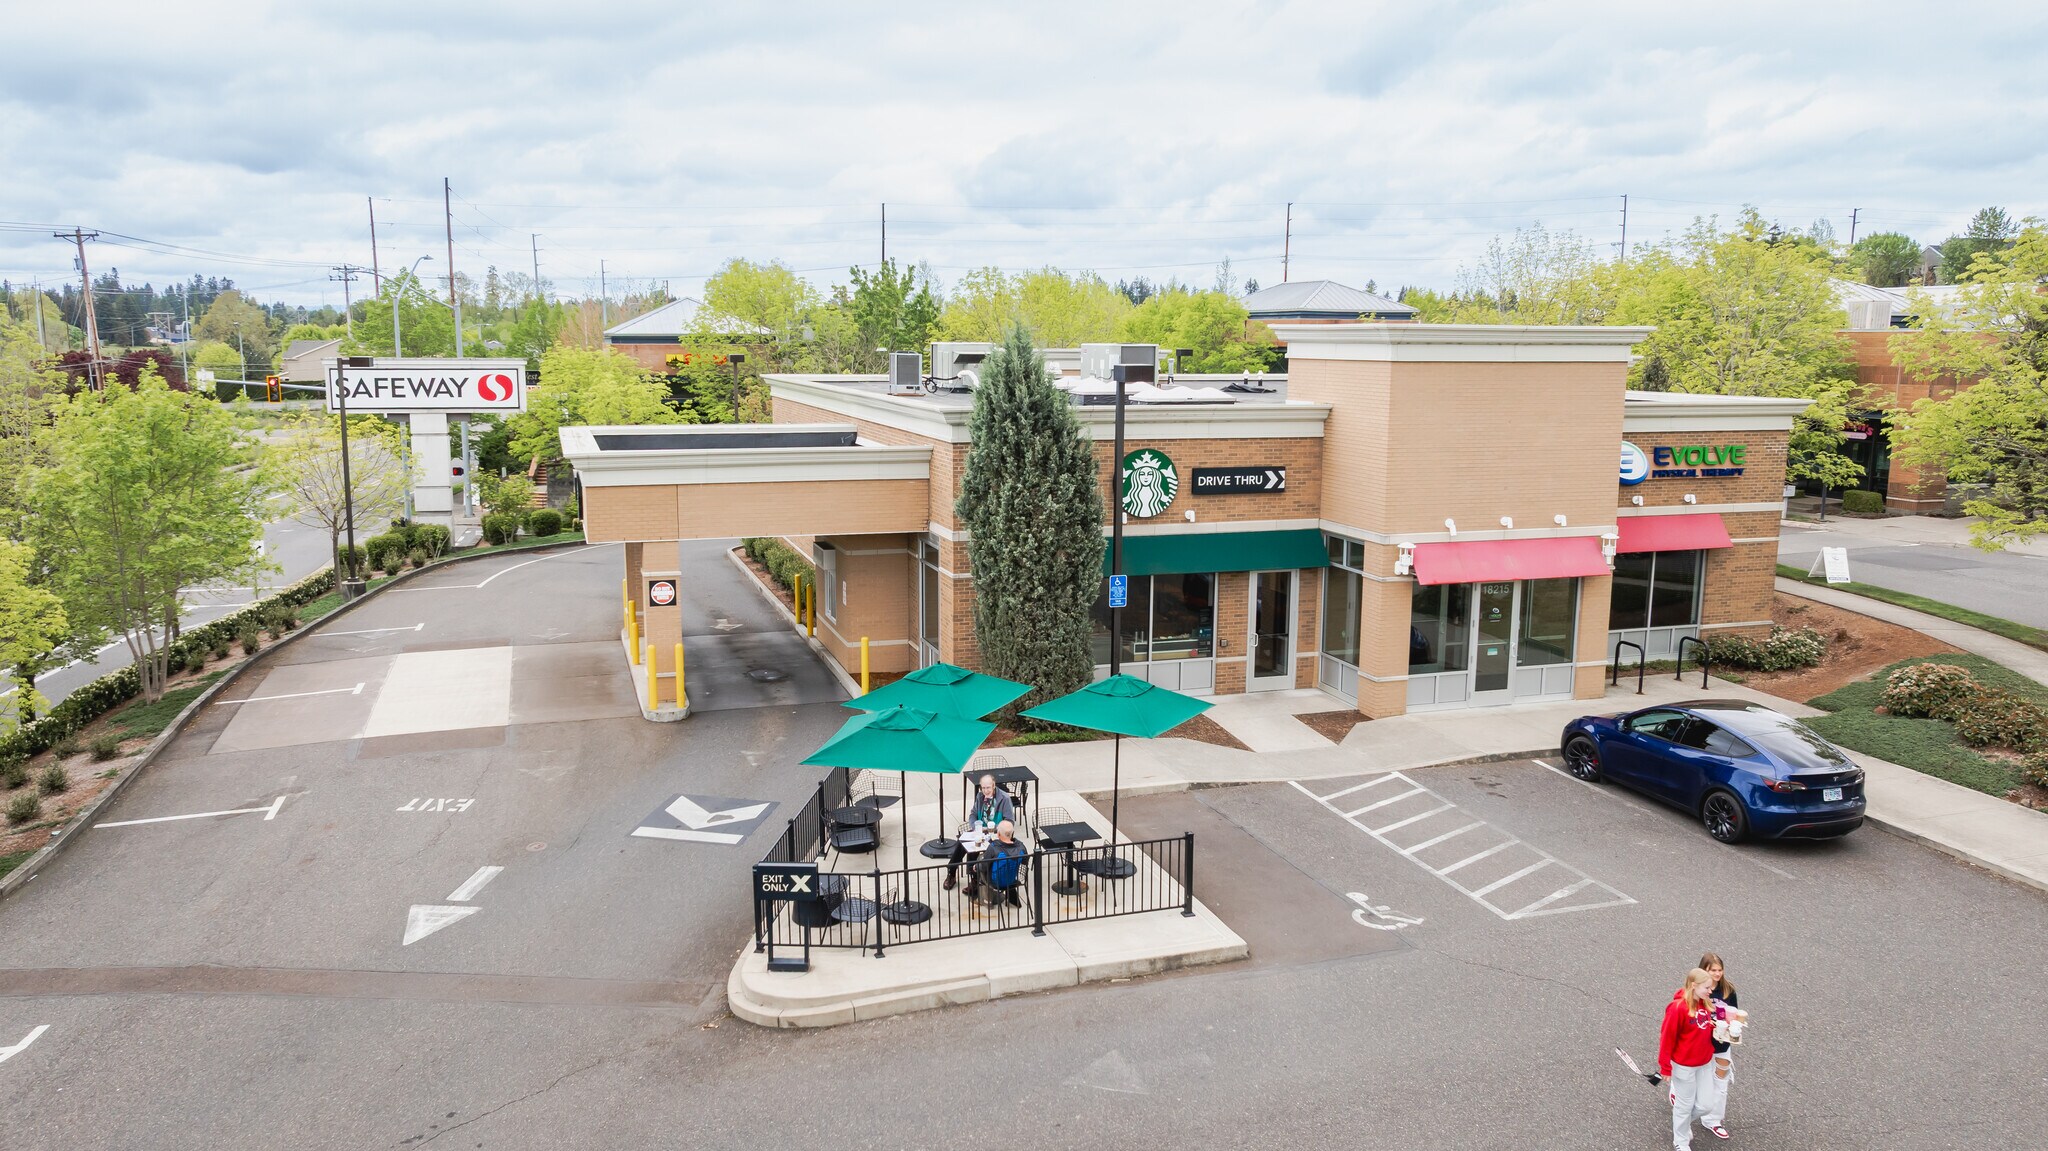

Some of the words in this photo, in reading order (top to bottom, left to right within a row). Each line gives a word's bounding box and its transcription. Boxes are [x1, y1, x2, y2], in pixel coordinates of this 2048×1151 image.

[335, 377, 469, 399] SAFEWAY
[1653, 445, 1748, 467] EVOLVE
[1198, 475, 1231, 486] DRIVE
[1234, 475, 1263, 486] THRU
[1483, 584, 1510, 595] 18215
[396, 798, 476, 812] EXIT
[762, 875, 784, 883] EXIT
